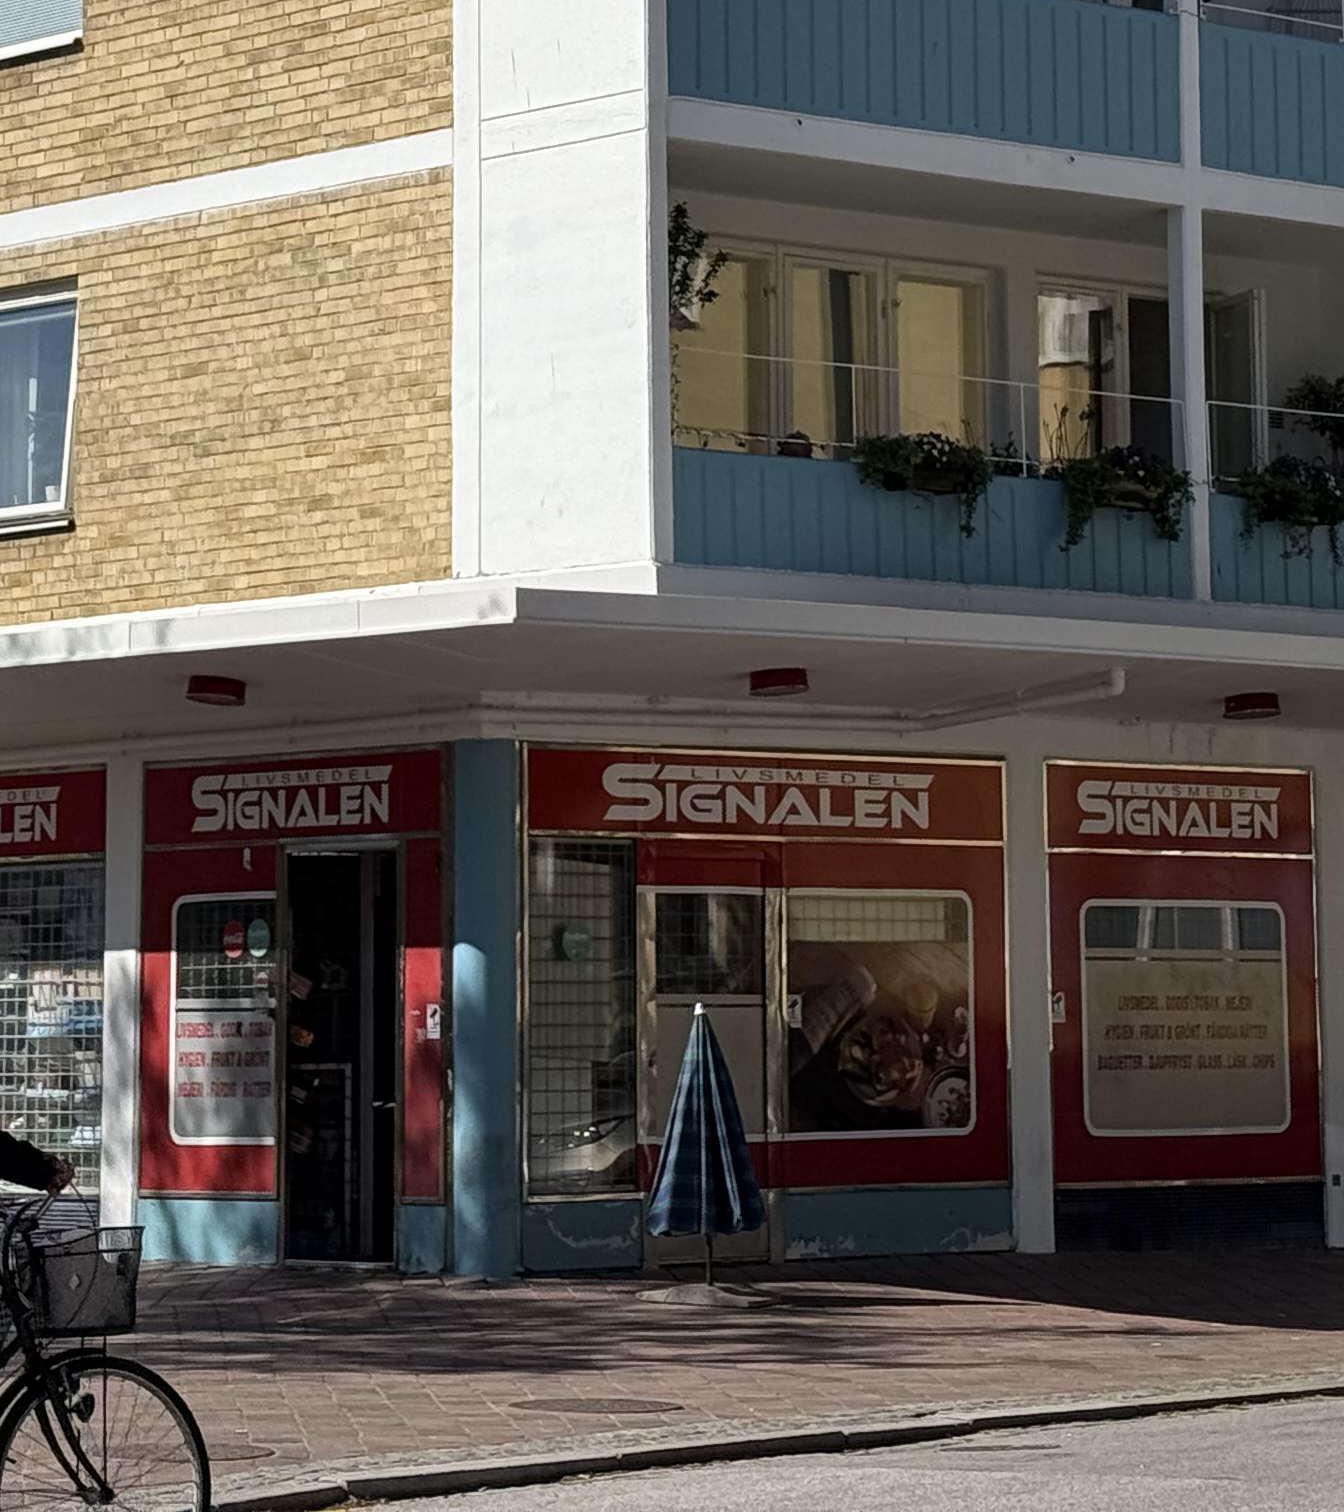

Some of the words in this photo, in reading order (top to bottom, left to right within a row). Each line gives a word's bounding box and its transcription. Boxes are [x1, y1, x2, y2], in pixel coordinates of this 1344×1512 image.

[242, 768, 373, 786] LIVSMEDEL
[690, 767, 905, 786] LIVSMEDEL
[1130, 783, 1264, 799] LIVSMEDEL
[191, 774, 390, 832] SIGNALEN
[602, 763, 930, 830] SIGNALEN
[1077, 780, 1278, 839] SIGNALEN
